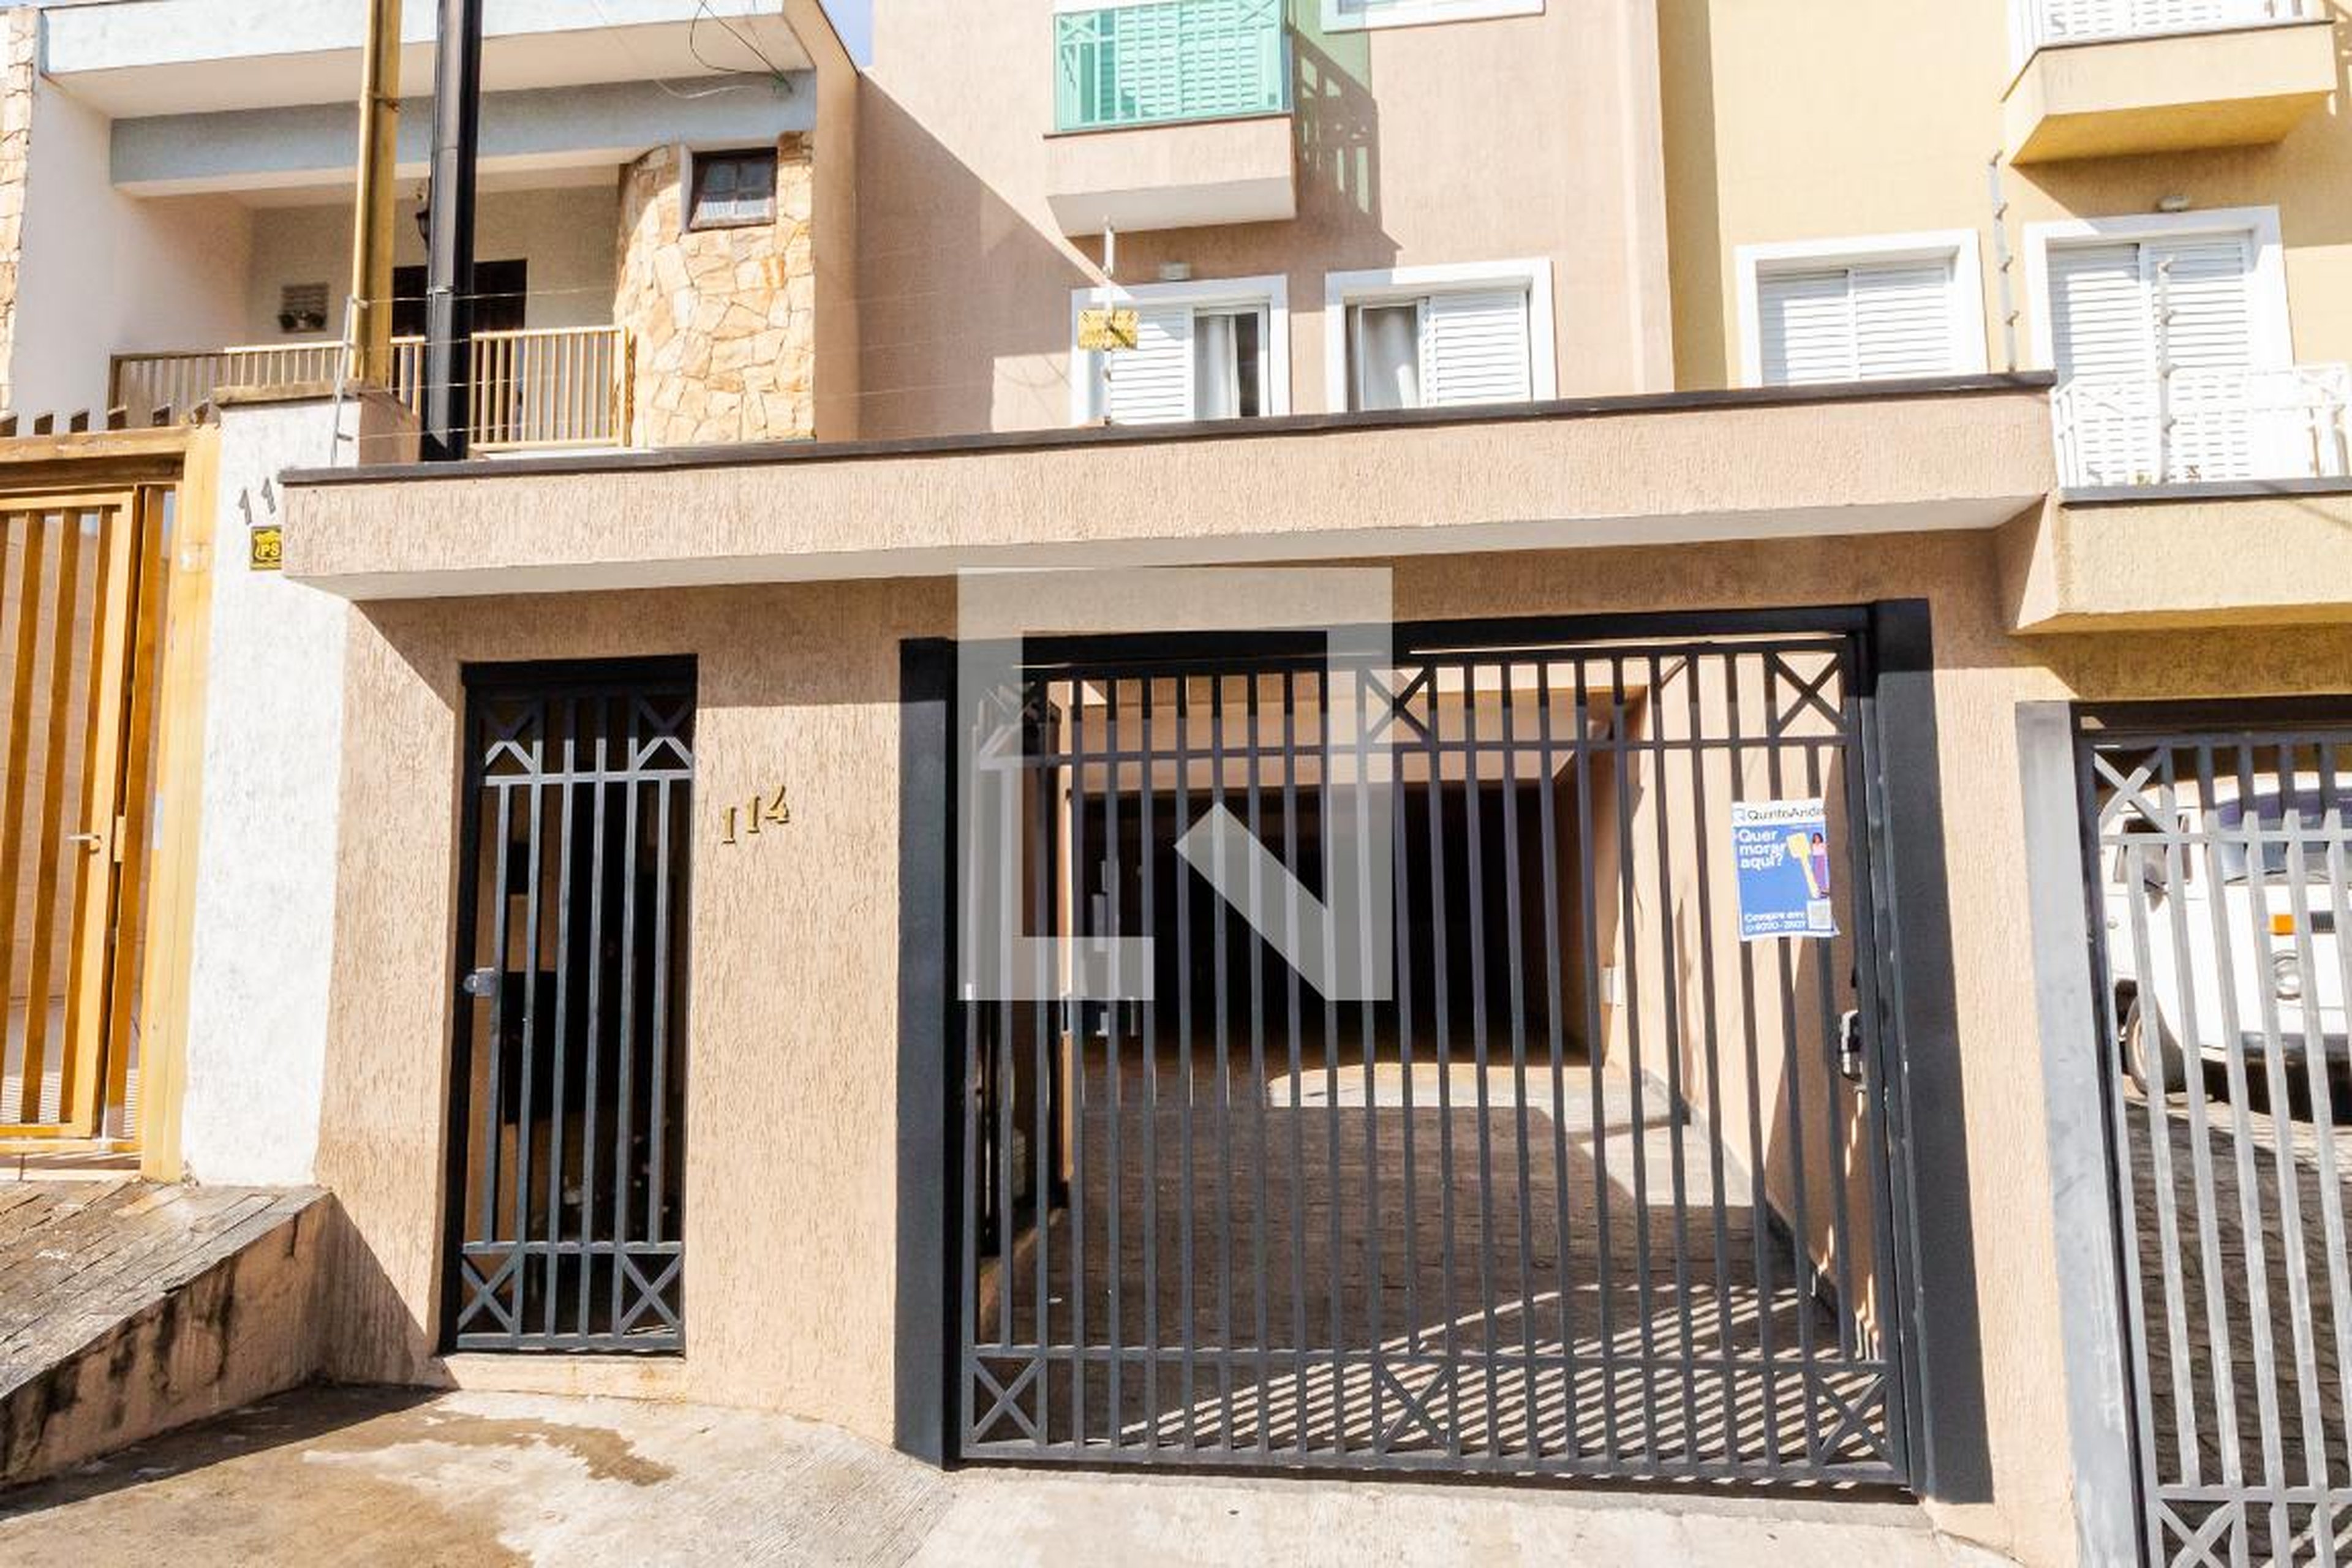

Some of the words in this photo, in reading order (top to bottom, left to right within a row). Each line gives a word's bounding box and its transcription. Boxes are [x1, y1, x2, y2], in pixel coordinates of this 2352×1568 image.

[722, 784, 790, 838] 114
[1738, 829, 1777, 843] Quer
[1740, 843, 1787, 856] morar
[1741, 853, 1783, 870] aqui?
